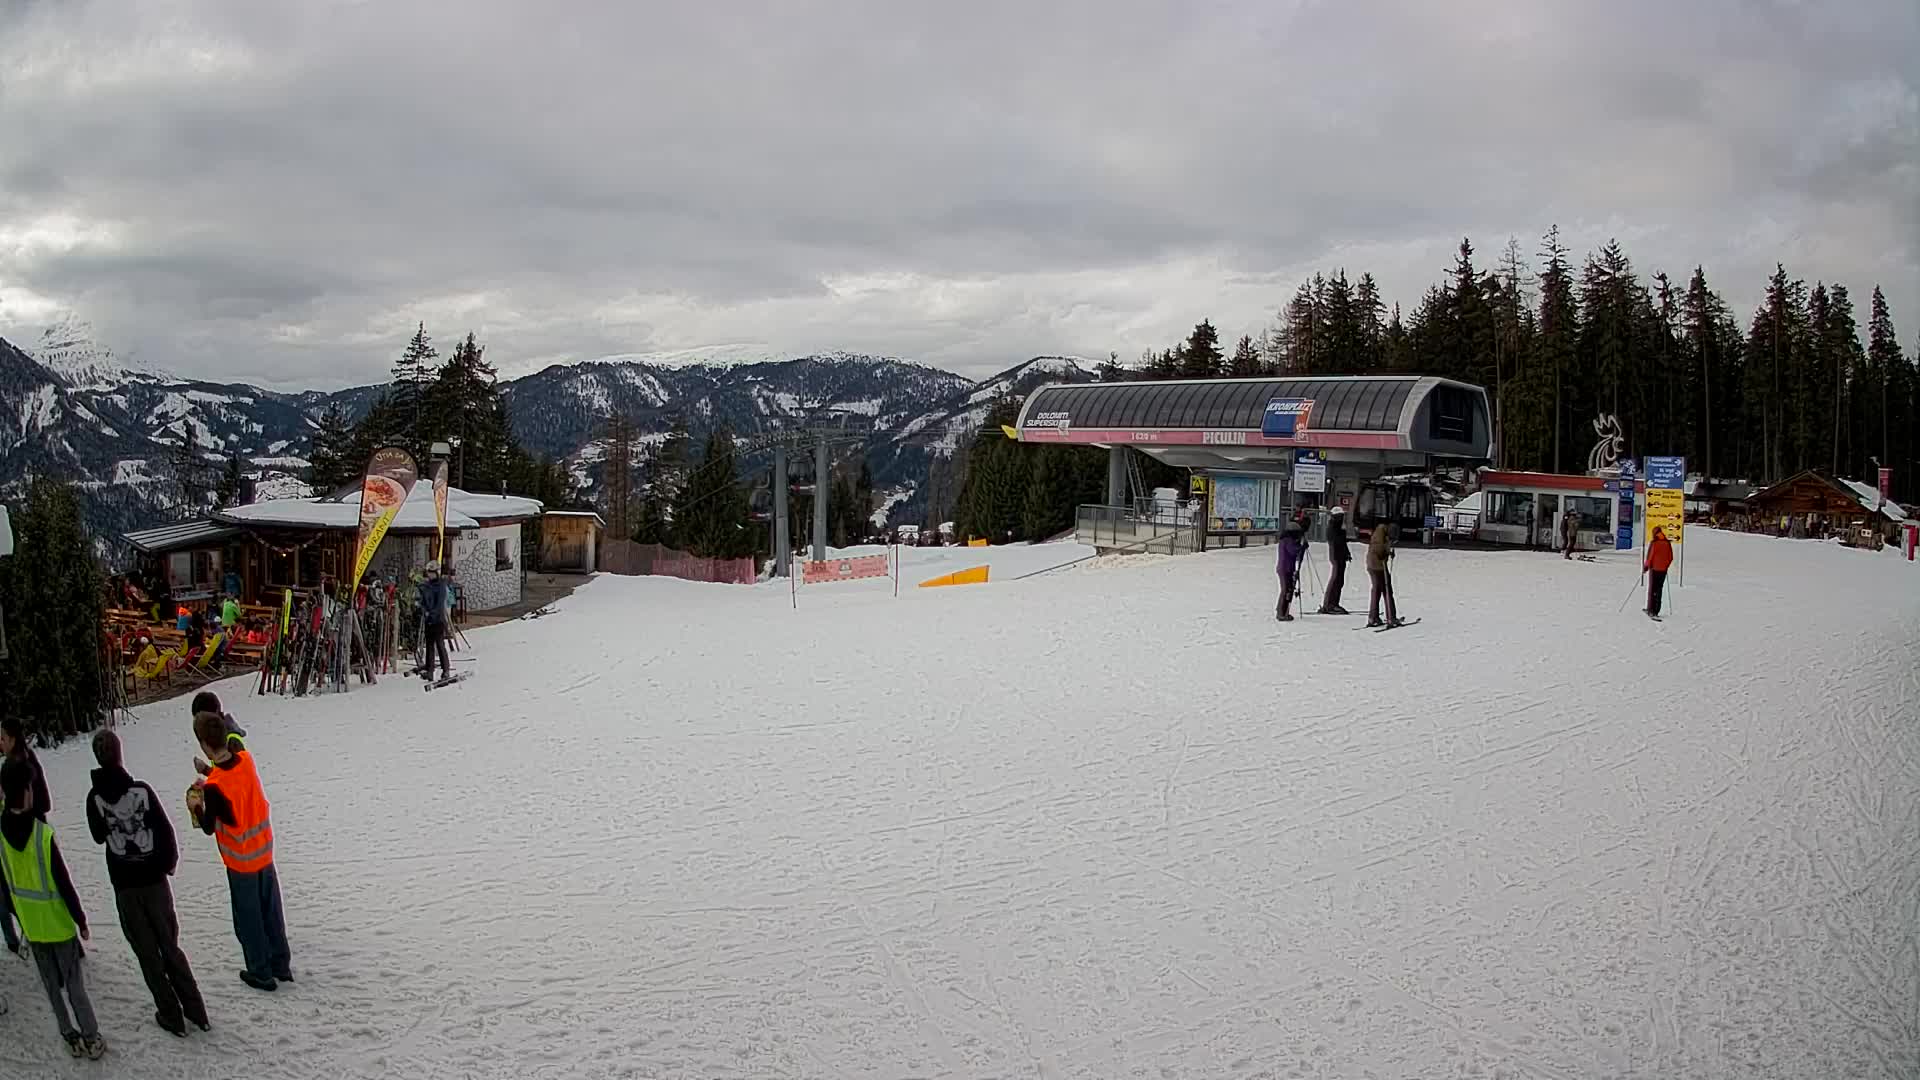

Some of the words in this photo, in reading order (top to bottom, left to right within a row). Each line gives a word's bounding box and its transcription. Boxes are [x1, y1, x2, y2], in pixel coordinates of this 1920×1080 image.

[1037, 412, 1069, 420] DOLOMITI
[1026, 419, 1060, 427] SUPERSKI
[1202, 432, 1246, 444] PICULIN
